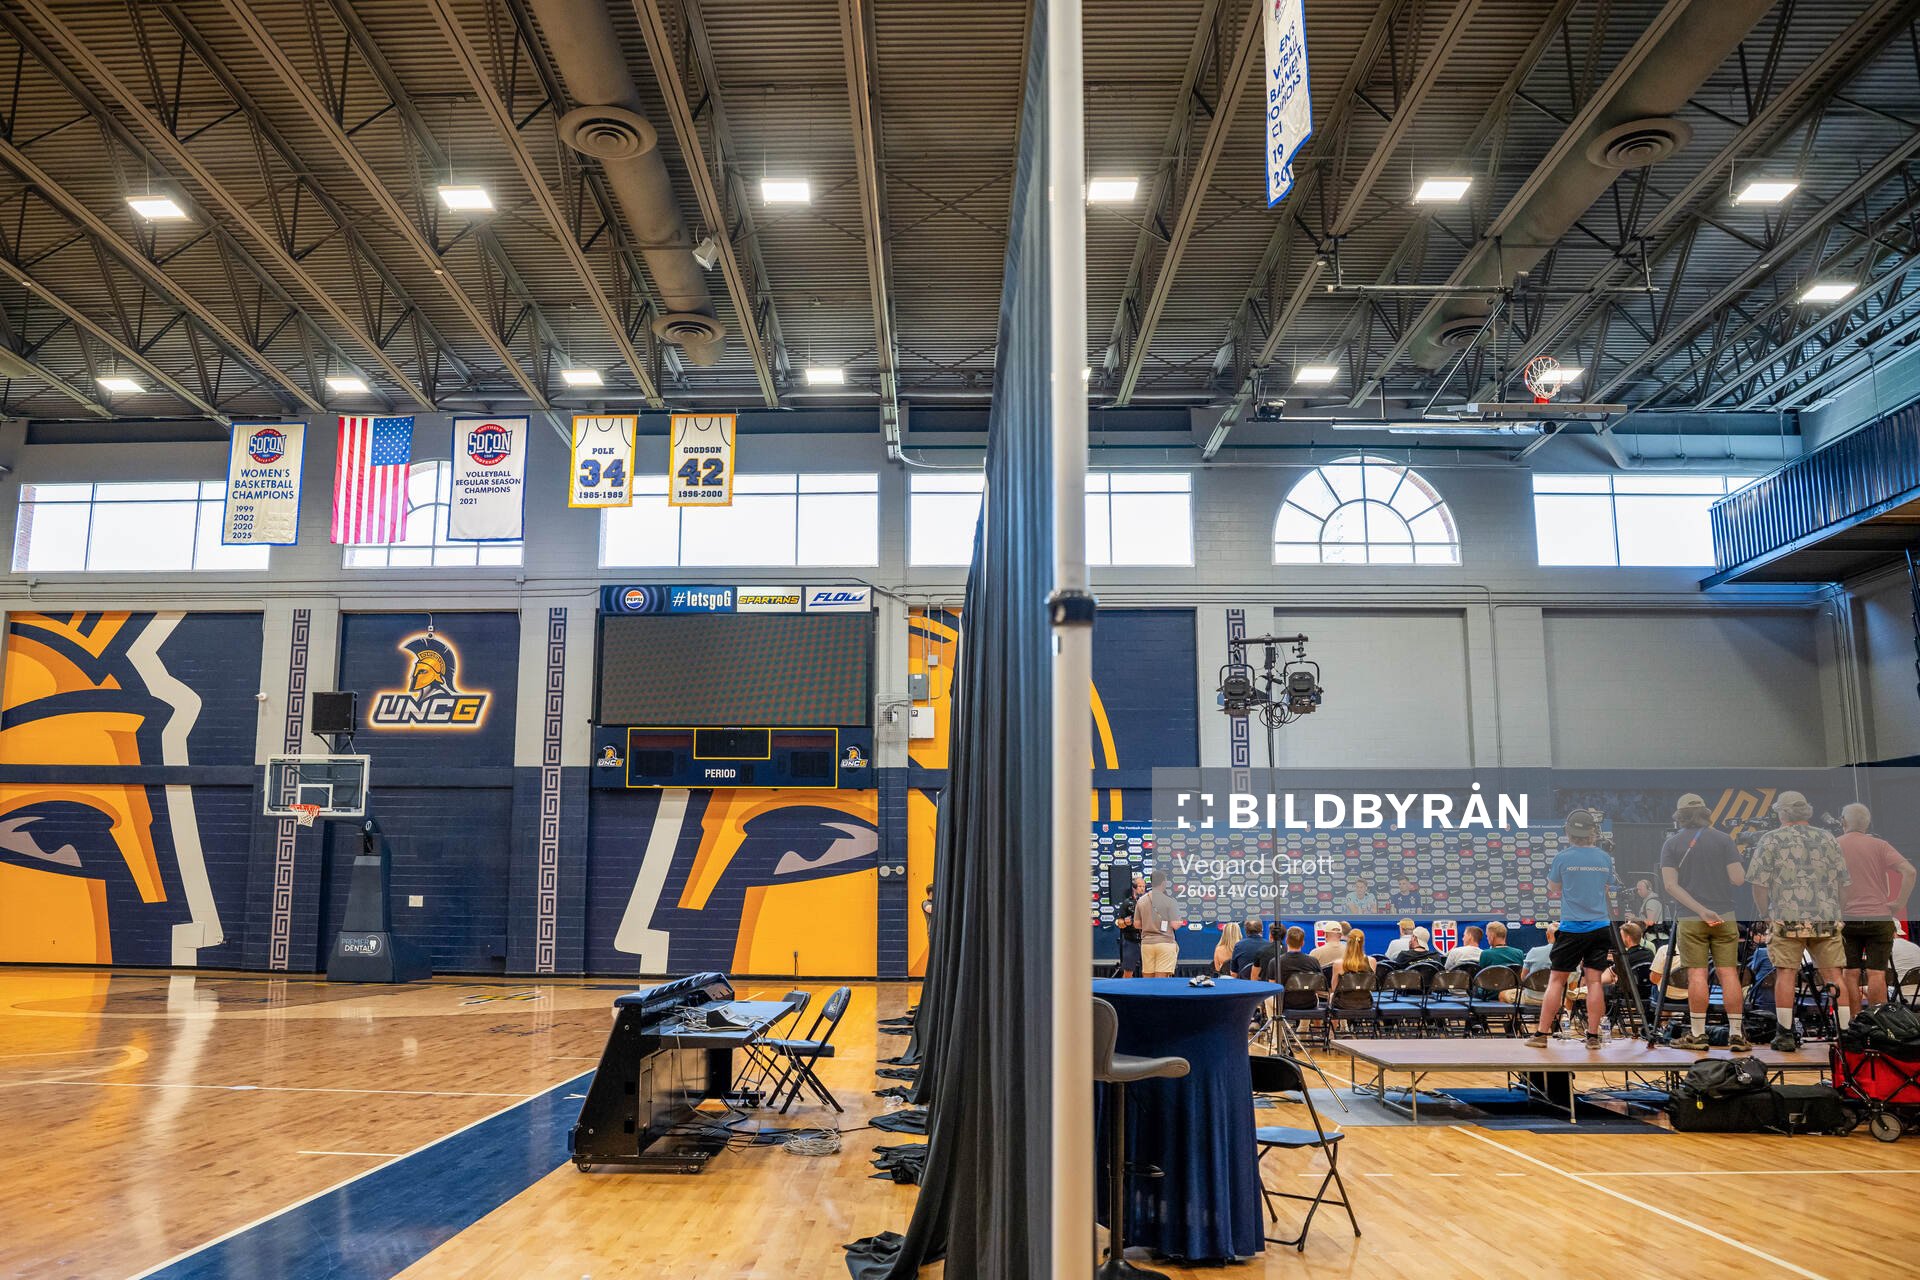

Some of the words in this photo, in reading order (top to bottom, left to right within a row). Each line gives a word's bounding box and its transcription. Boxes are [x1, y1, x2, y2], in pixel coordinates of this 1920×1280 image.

[250, 435, 287, 455] SOCON
[468, 430, 513, 455] SOCON
[592, 447, 615, 455] POLK
[683, 446, 722, 454] GOODSON
[241, 468, 290, 478] WOMEN'S
[465, 470, 512, 478] VOLLEYBALL
[579, 458, 626, 488] 34
[677, 457, 724, 487] 42
[234, 479, 293, 489] BASKETBALL
[490, 478, 521, 486] SEASON
[232, 490, 294, 500] CHAMPIONS
[464, 486, 511, 494] CHAMPIONS
[234, 514, 254, 522] 2002
[233, 522, 253, 531] 2020
[672, 590, 732, 610] #letsgoG
[738, 595, 800, 605] SPARTANS
[813, 592, 865, 602] FLOW
[376, 694, 481, 724] UNCG
[597, 758, 624, 768] UNCG
[841, 758, 868, 768] UNCG
[704, 769, 736, 779] PERIOD
[341, 937, 370, 946] PREMIER
[344, 944, 371, 952] DENTAL
